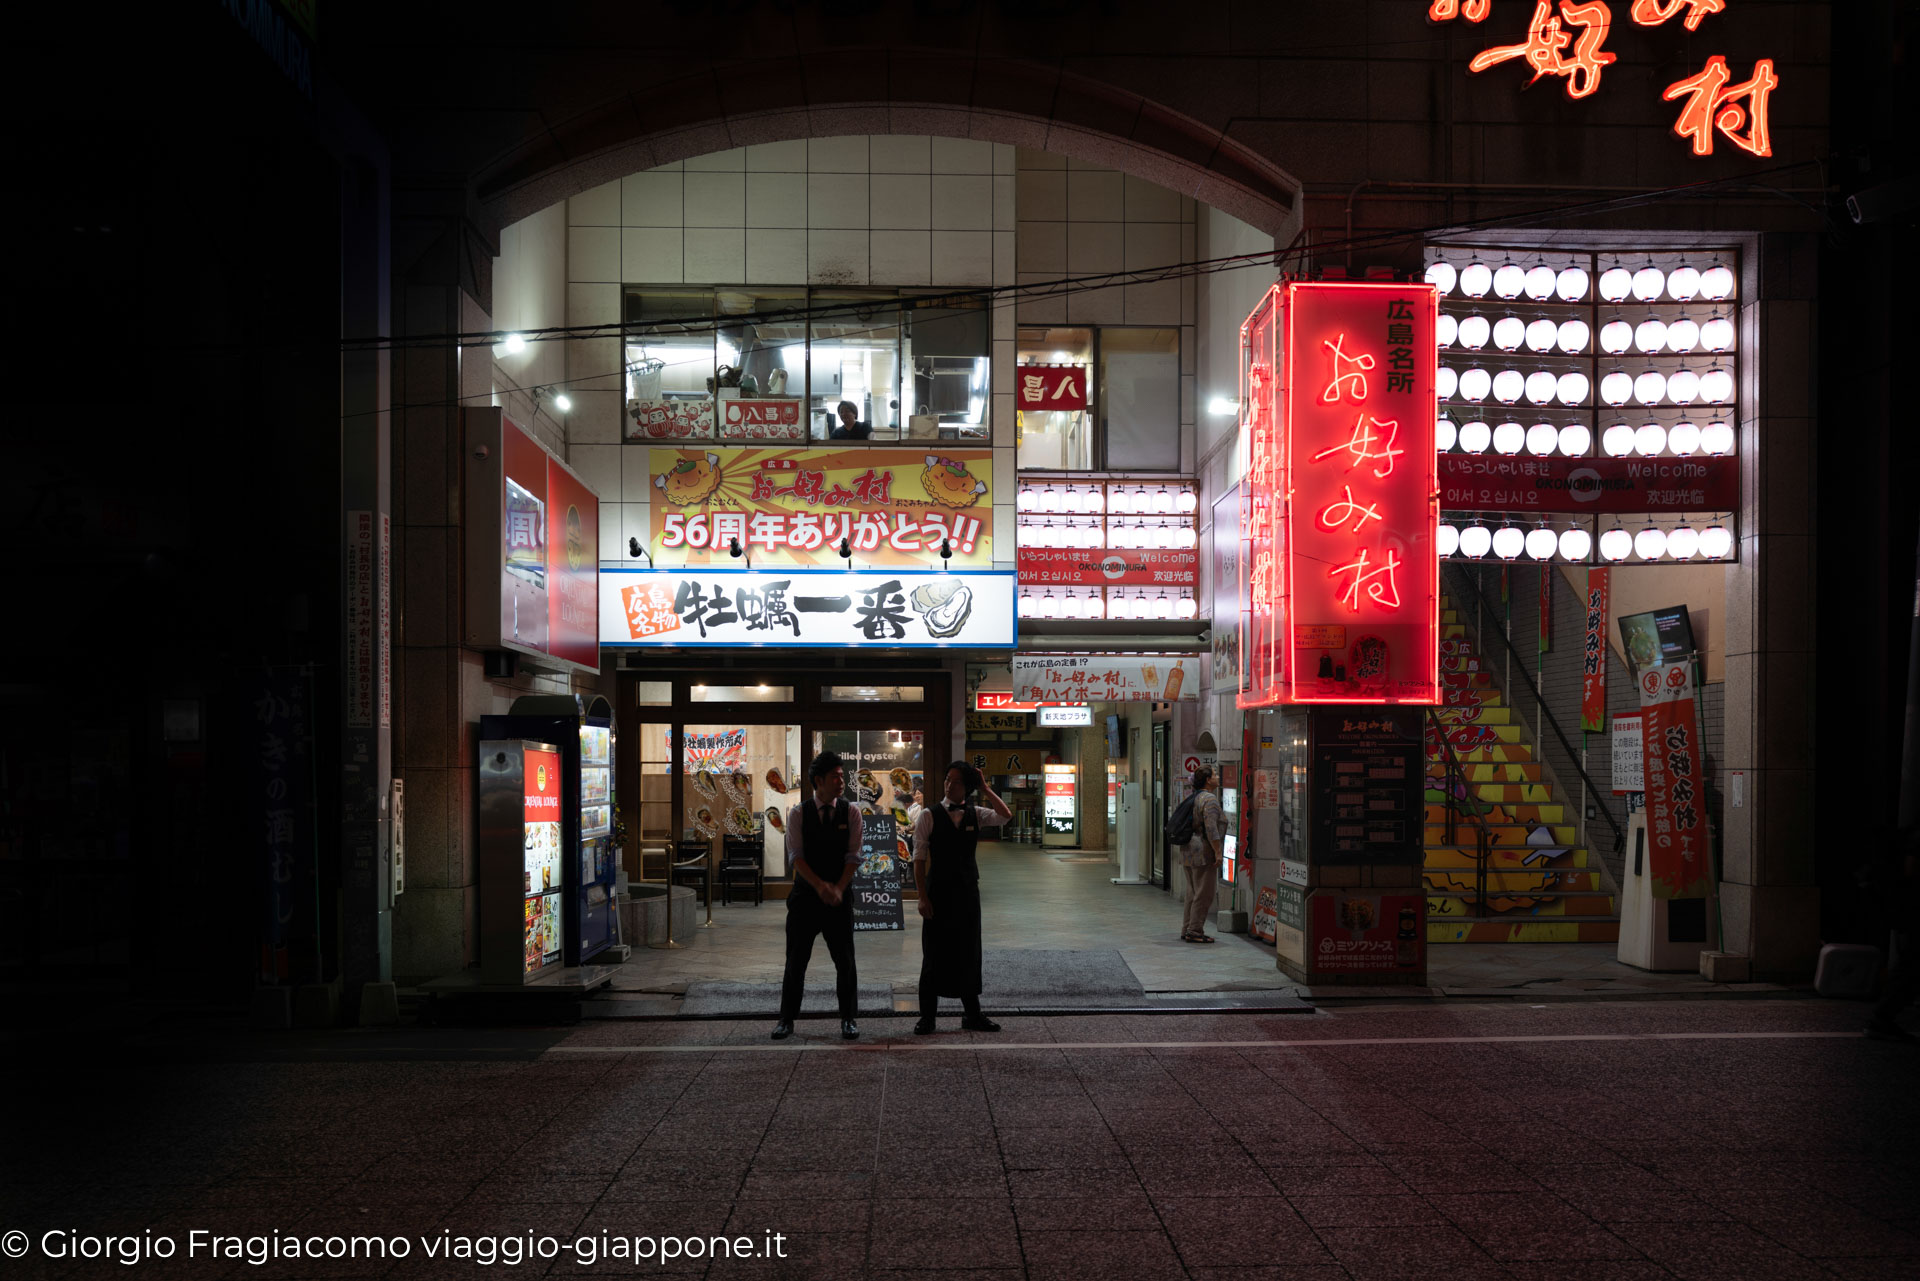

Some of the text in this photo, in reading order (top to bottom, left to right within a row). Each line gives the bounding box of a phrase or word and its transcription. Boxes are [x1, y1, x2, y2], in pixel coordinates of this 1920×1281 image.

[1388, 299, 1414, 394] 広島名所
[745, 406, 779, 421] 八昌
[767, 460, 791, 469] 広島
[1314, 333, 1404, 611] お好み村
[1448, 459, 1551, 476] いらっしゃいませ
[1627, 463, 1707, 478] Welcome
[751, 469, 894, 506] お好み村
[1535, 477, 1636, 492] OKONOMIMURA
[1446, 488, 1540, 505] 어서 오십시오
[1646, 489, 1705, 505] 欢迎光临
[1020, 552, 1090, 562] いらっしゃいませ
[1140, 553, 1196, 564] Welcome
[1078, 563, 1148, 573] OKONOMIMURA
[1018, 571, 1083, 582] 어서 오십시오
[1153, 570, 1194, 583] 欢迎光临
[673, 579, 915, 640] 牡蠣一番
[1045, 712, 1087, 721] 新天地プラザ
[1336, 940, 1394, 952] ミツワソース
